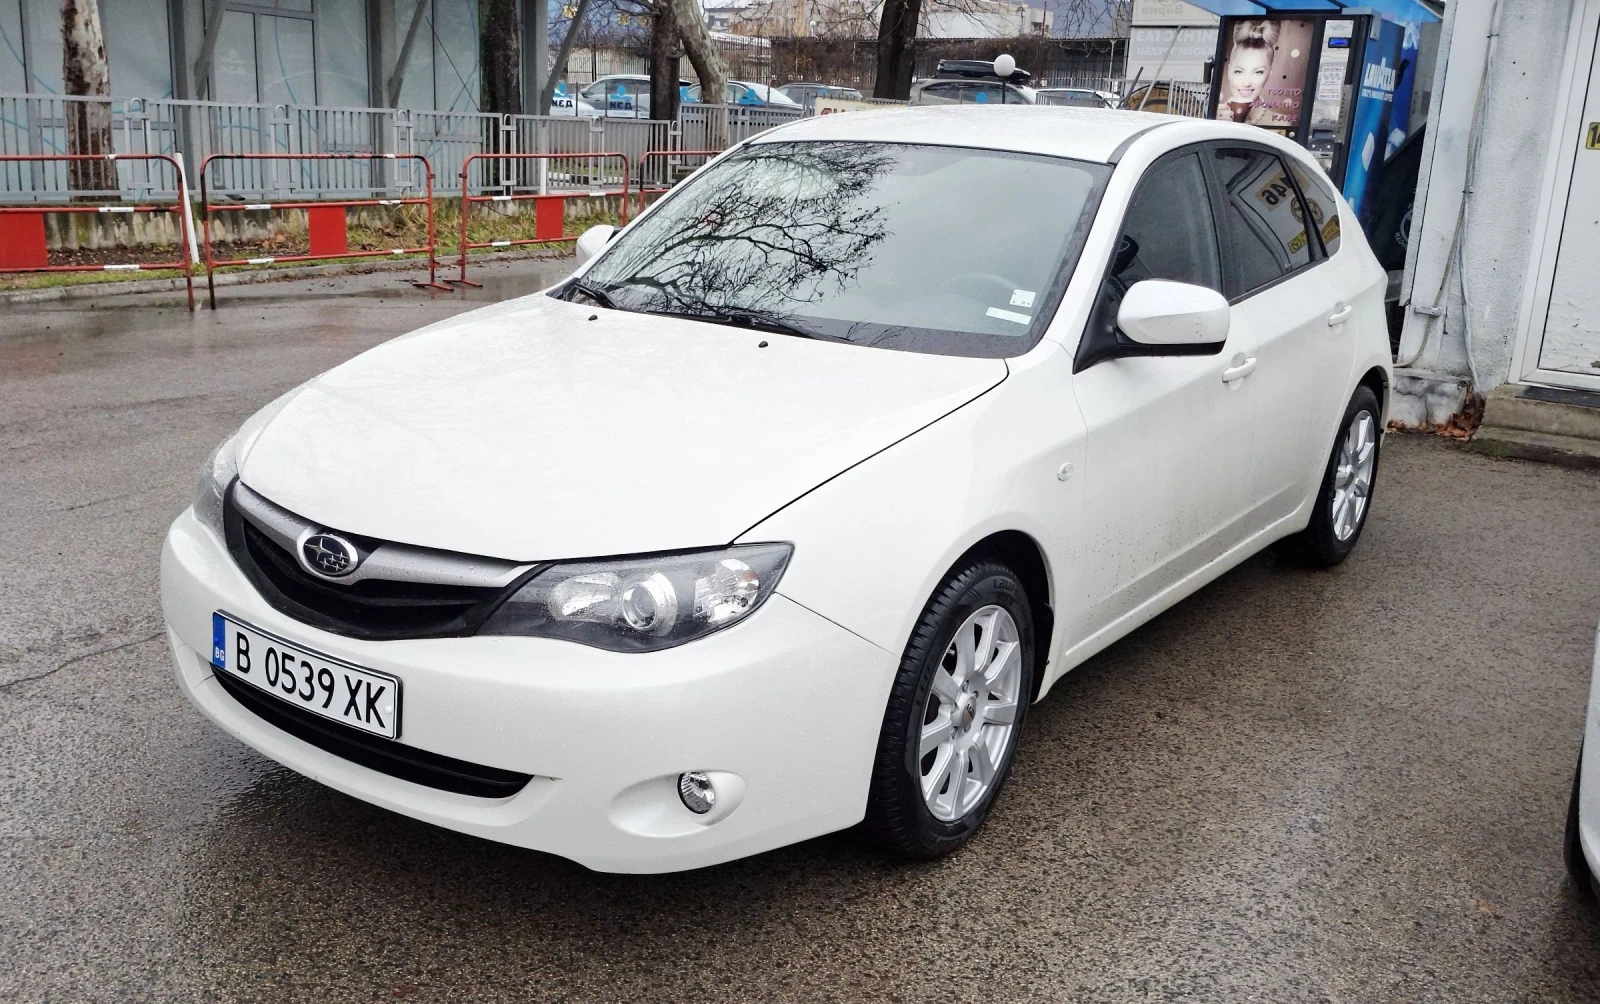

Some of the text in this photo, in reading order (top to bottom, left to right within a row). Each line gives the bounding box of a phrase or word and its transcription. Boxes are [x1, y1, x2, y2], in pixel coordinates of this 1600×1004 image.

[1272, 114, 1298, 122] КАФЕ
[214, 646, 225, 662] BG
[265, 646, 335, 709] 0539
